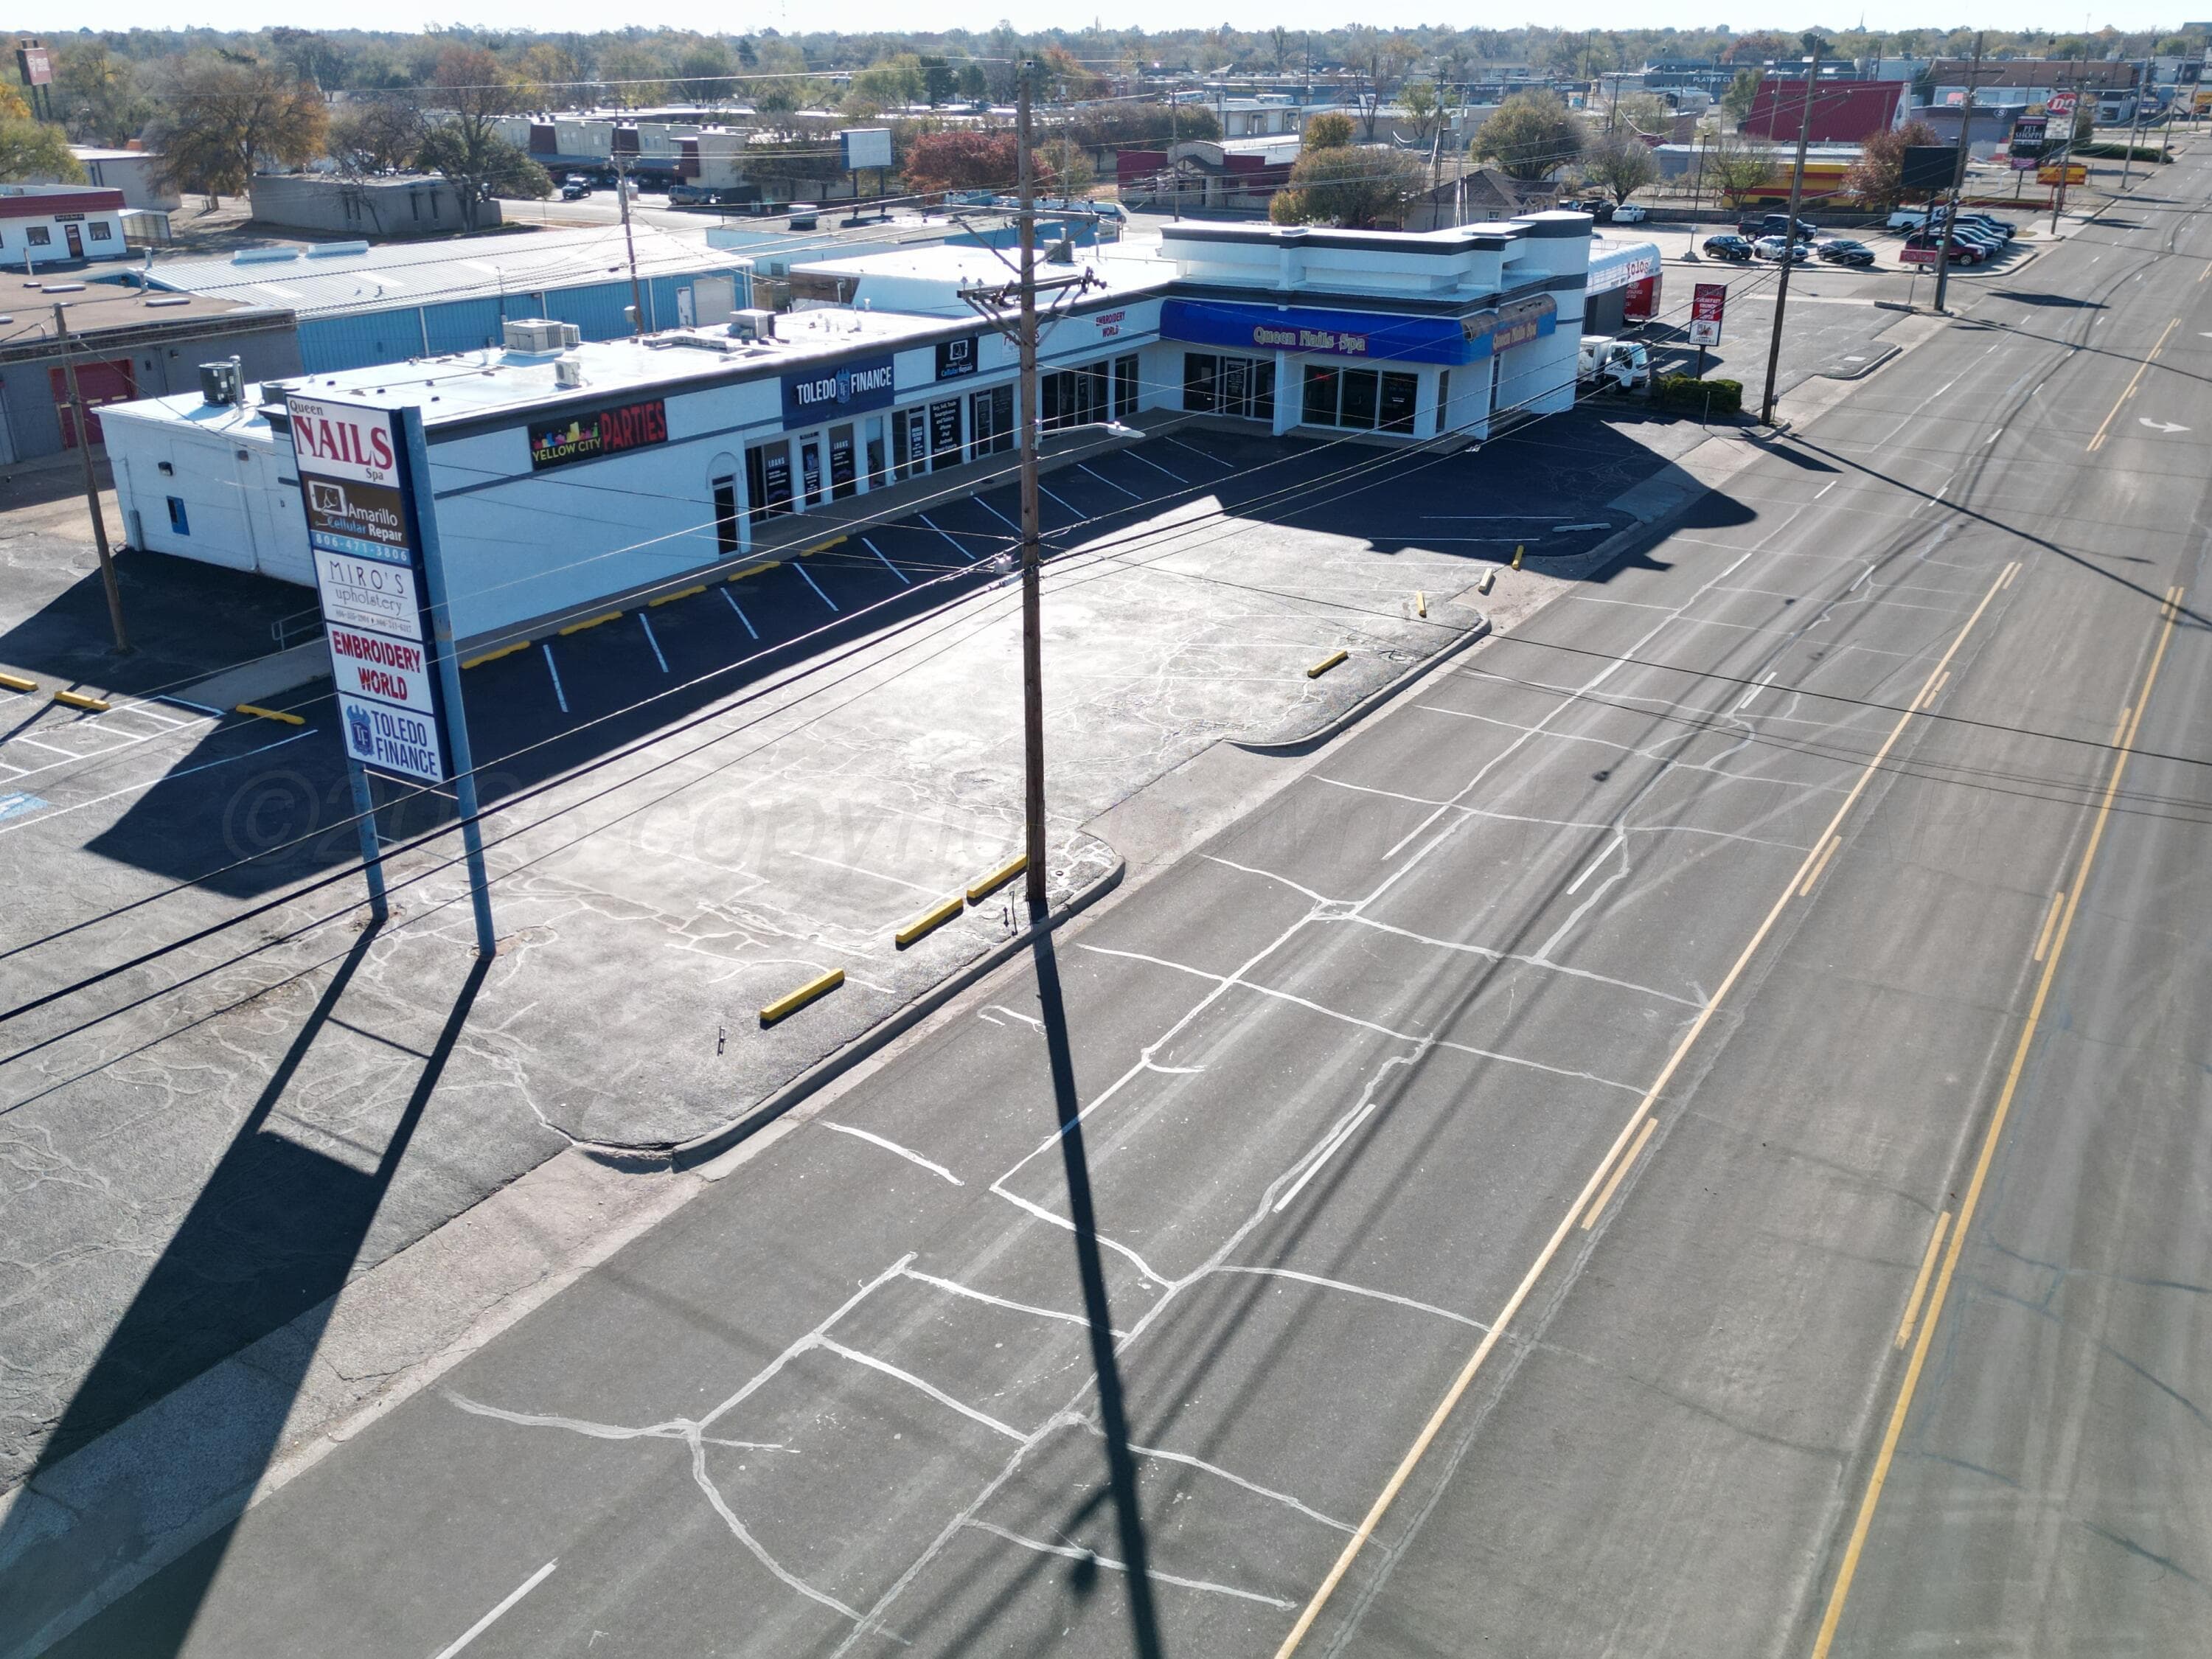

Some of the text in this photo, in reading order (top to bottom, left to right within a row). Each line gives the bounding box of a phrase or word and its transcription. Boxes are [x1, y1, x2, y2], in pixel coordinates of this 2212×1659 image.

[2051, 97, 2076, 110] DQ
[1096, 310, 1126, 327] EMBROIDERY
[1102, 326, 1119, 338] WORLD
[1253, 327, 1365, 354] Queen Nails Spa
[796, 378, 836, 405] TOLEDO
[851, 366, 891, 394] FINANCE
[289, 400, 324, 416] Queen
[600, 400, 666, 451] PARTIES
[291, 414, 393, 470] NAILS
[532, 437, 601, 462] YELLOW CITY
[833, 440, 848, 450] LOANS
[366, 467, 384, 482] Spa
[768, 457, 785, 467] LOANS
[348, 502, 398, 527] Amarillo
[327, 516, 403, 542] Cellular Repair
[315, 532, 408, 562] 806-471-3806
[330, 560, 404, 594] MIRO'S
[335, 588, 403, 616] upholstery
[332, 630, 420, 674] EMBROIDERY
[357, 667, 408, 701] WORLD
[371, 710, 428, 748] TOLEDO
[375, 738, 438, 776] FINANCE
